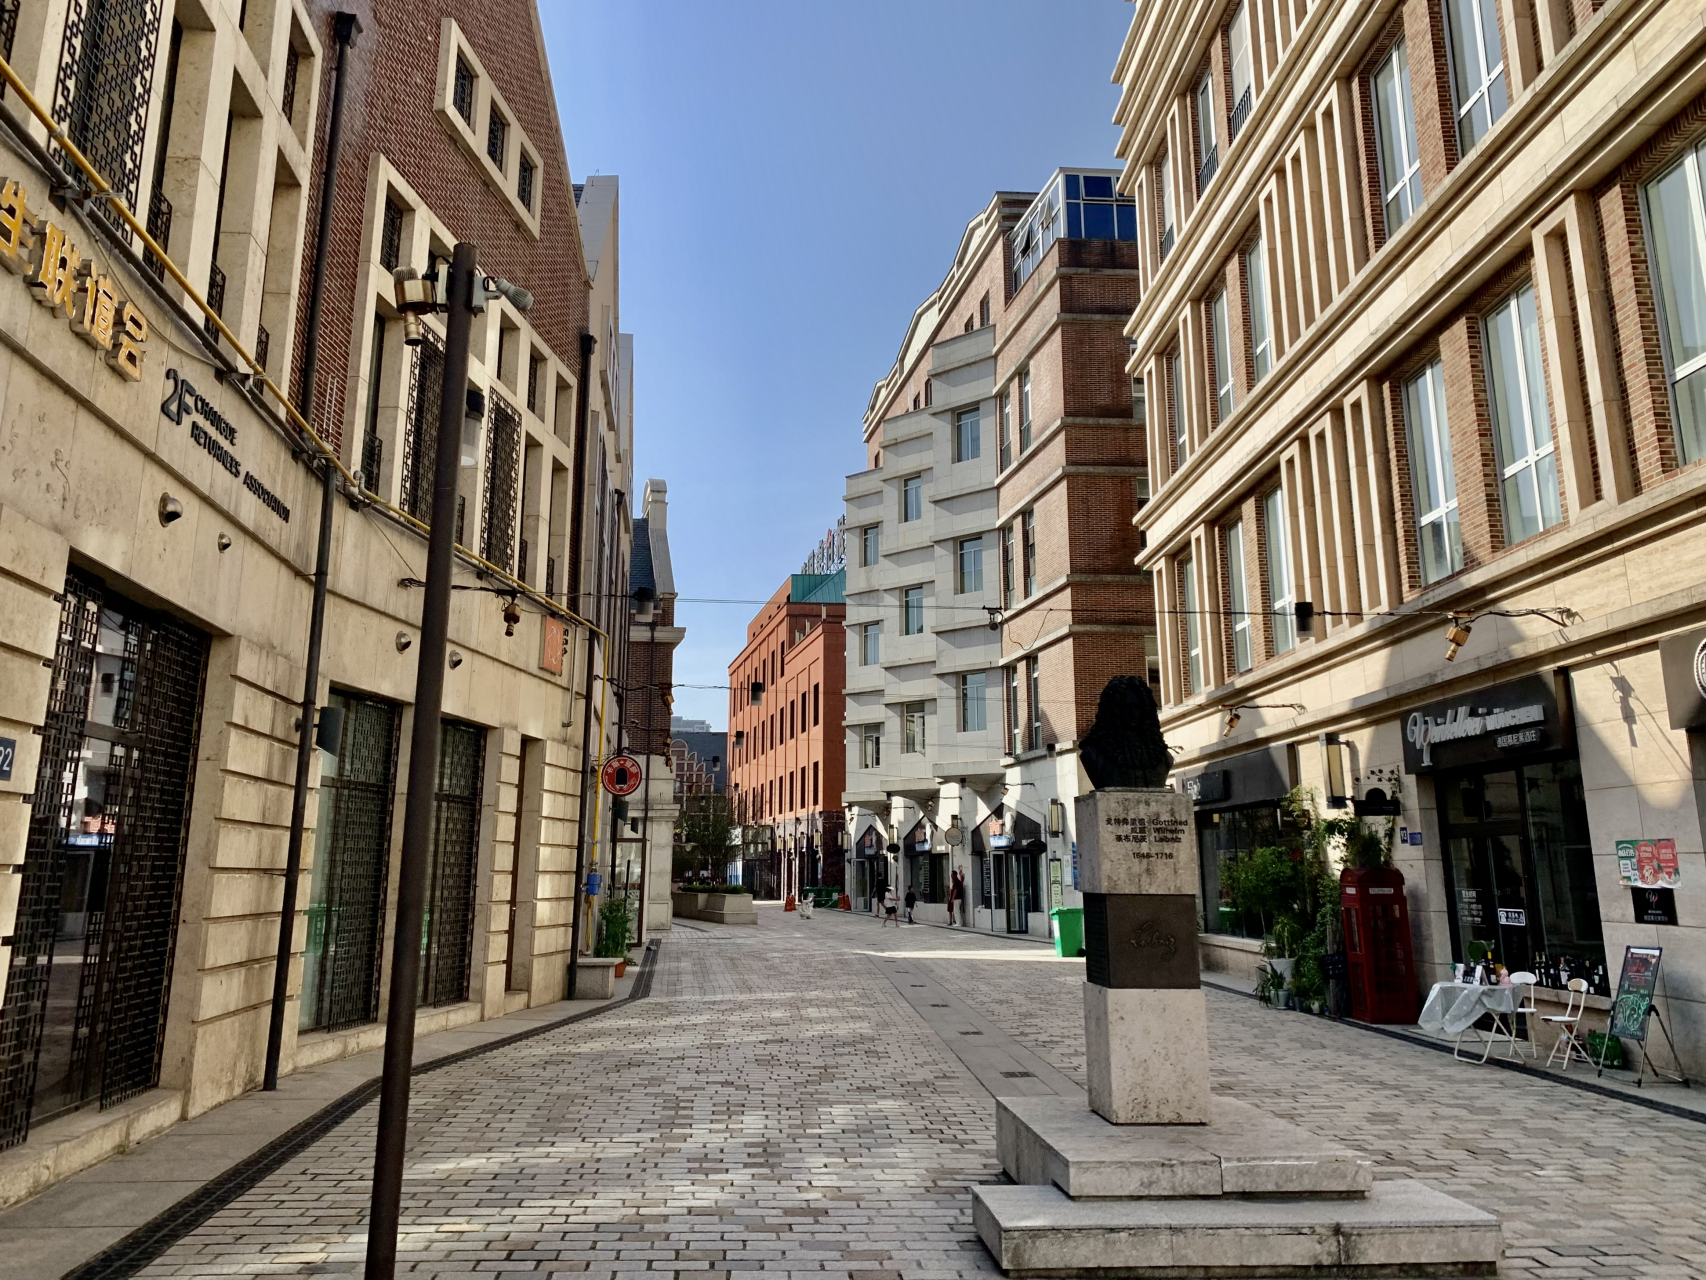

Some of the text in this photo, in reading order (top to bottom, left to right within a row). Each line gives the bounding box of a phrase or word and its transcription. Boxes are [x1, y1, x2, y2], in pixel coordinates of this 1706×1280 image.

[161, 368, 238, 447] 2F CHANGDE
[190, 420, 291, 524] RETURNEES ASSOCIATION
[1485, 705, 1544, 731] MÜNCHEN
